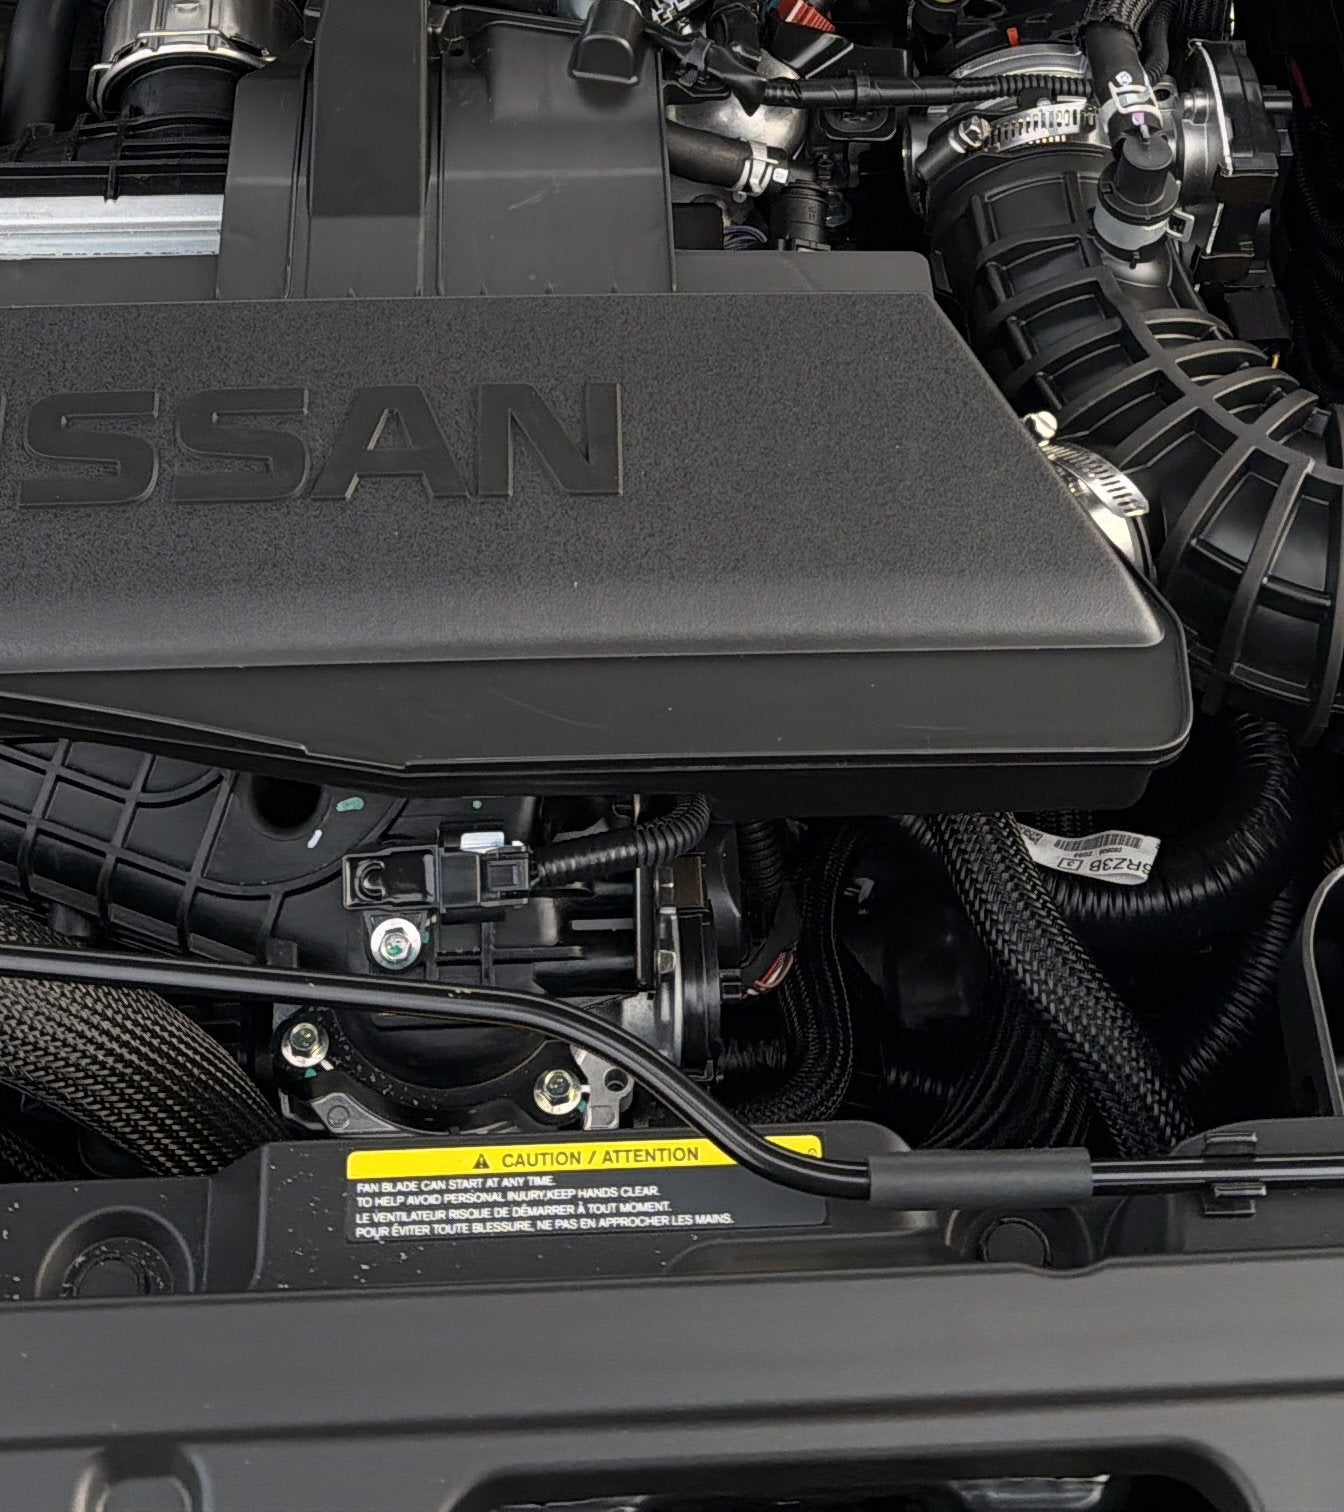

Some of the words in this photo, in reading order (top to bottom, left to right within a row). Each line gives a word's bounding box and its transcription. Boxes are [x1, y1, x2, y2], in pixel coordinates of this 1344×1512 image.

[502, 1150, 582, 1168] CAUTION
[602, 1147, 699, 1165] ATTENTION
[357, 1182, 380, 1194] FAN
[381, 1180, 419, 1192] BLADE
[421, 1179, 446, 1191] CAN
[449, 1178, 484, 1190] START
[486, 1177, 499, 1188] AT
[501, 1176, 525, 1187] ANY
[357, 1196, 372, 1208] TO
[375, 1195, 405, 1207] HELP
[407, 1194, 441, 1206] AVOID
[444, 1192, 505, 1205] PERSONAL
[578, 1186, 618, 1198] HANDS
[357, 1212, 370, 1223] LE
[372, 1209, 446, 1223] VENTILATEUR
[449, 1207, 491, 1219] RISQUE
[493, 1206, 511, 1217] DE
[513, 1203, 575, 1216] DÉMARRER
[577, 1201, 587, 1214] À
[588, 1201, 617, 1214] TOUT
[356, 1227, 389, 1239] POUR
[392, 1224, 431, 1236] ÉVITER
[434, 1223, 469, 1234] TOUTE
[536, 1219, 553, 1230] NE
[555, 1218, 578, 1230] PAS
[579, 1217, 596, 1228] EN
[598, 1215, 670, 1228] APPROCHER
[672, 1214, 693, 1226] LES
